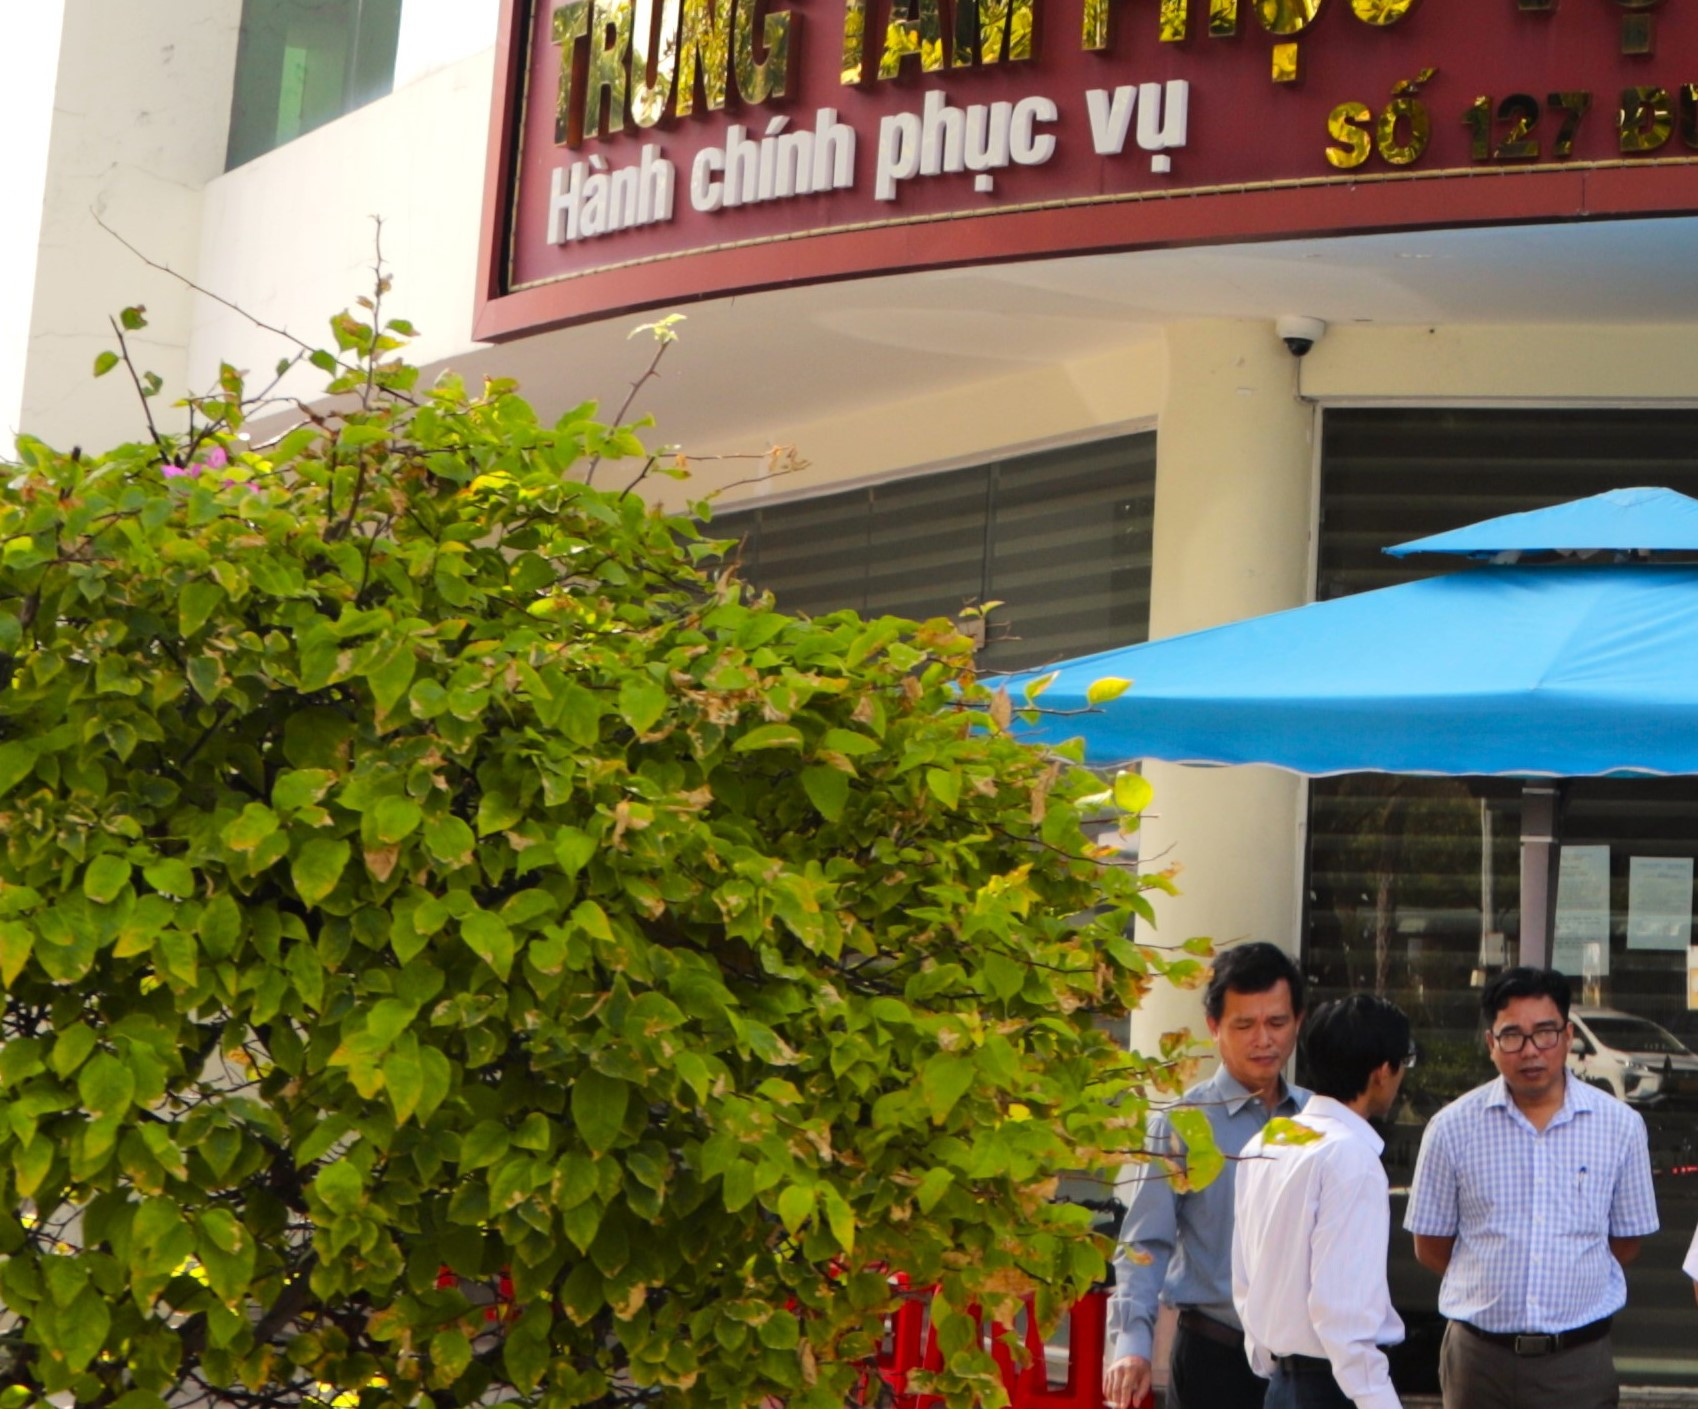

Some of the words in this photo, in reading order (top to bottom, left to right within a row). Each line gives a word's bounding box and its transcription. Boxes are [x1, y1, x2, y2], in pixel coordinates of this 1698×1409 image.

[547, 143, 674, 244] Hành
[692, 107, 856, 212] chính
[875, 90, 1057, 201] phục
[1086, 79, 1189, 174] vụ
[1326, 68, 1439, 169] SỐ
[1462, 92, 1591, 161] 127
